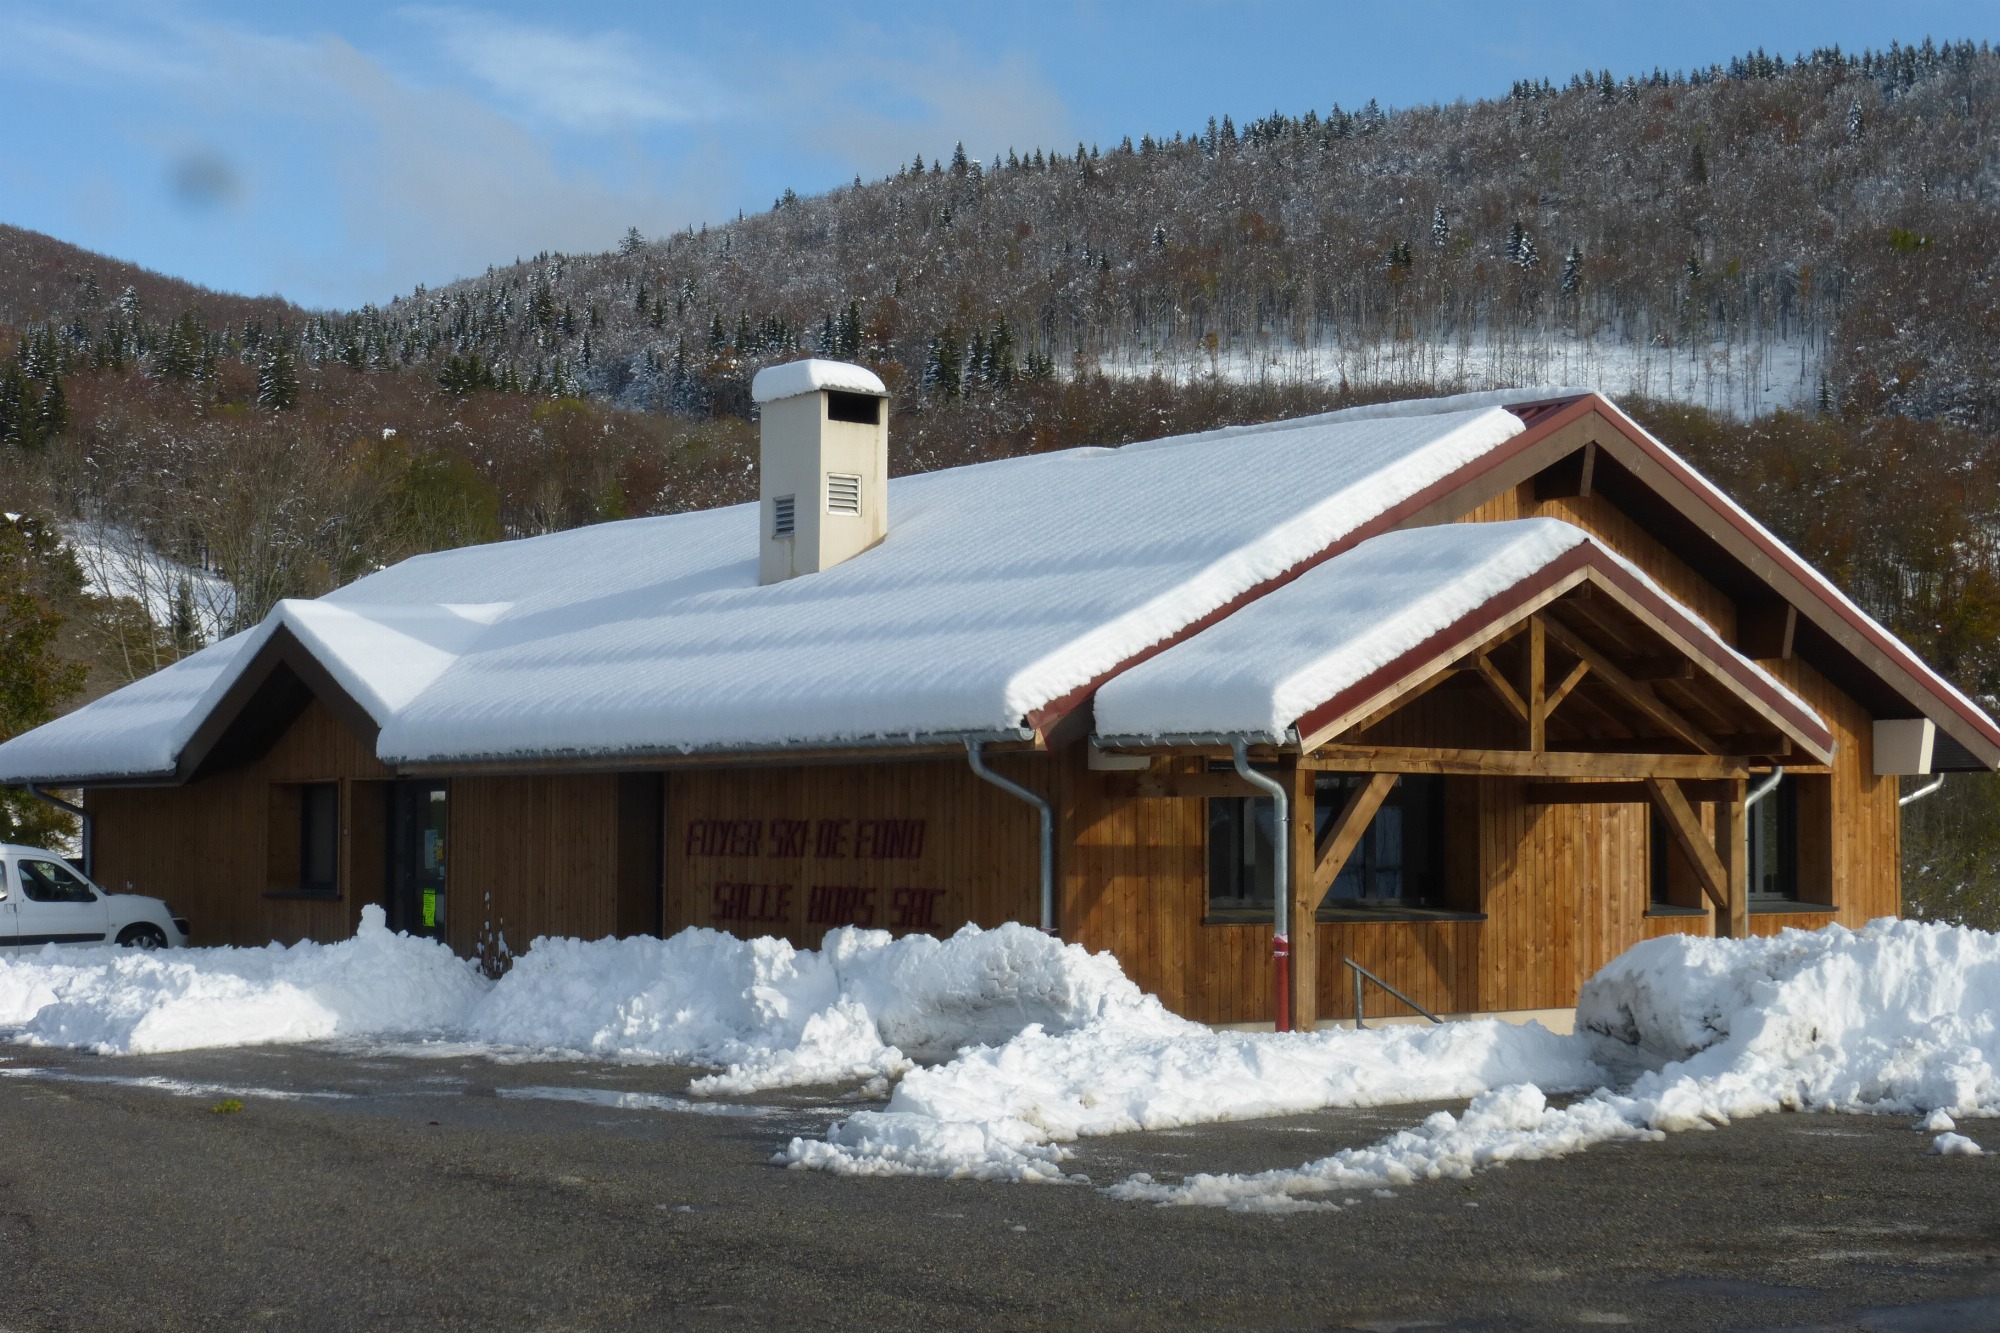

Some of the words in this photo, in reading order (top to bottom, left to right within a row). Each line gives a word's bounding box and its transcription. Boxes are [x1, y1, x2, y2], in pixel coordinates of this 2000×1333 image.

[686, 819, 762, 857] FOYER
[767, 819, 808, 858] SKI
[814, 819, 850, 858] DE
[854, 819, 926, 859] FOND
[711, 881, 792, 922] SALLE
[807, 886, 876, 927] HORS
[890, 887, 946, 929] SAC
